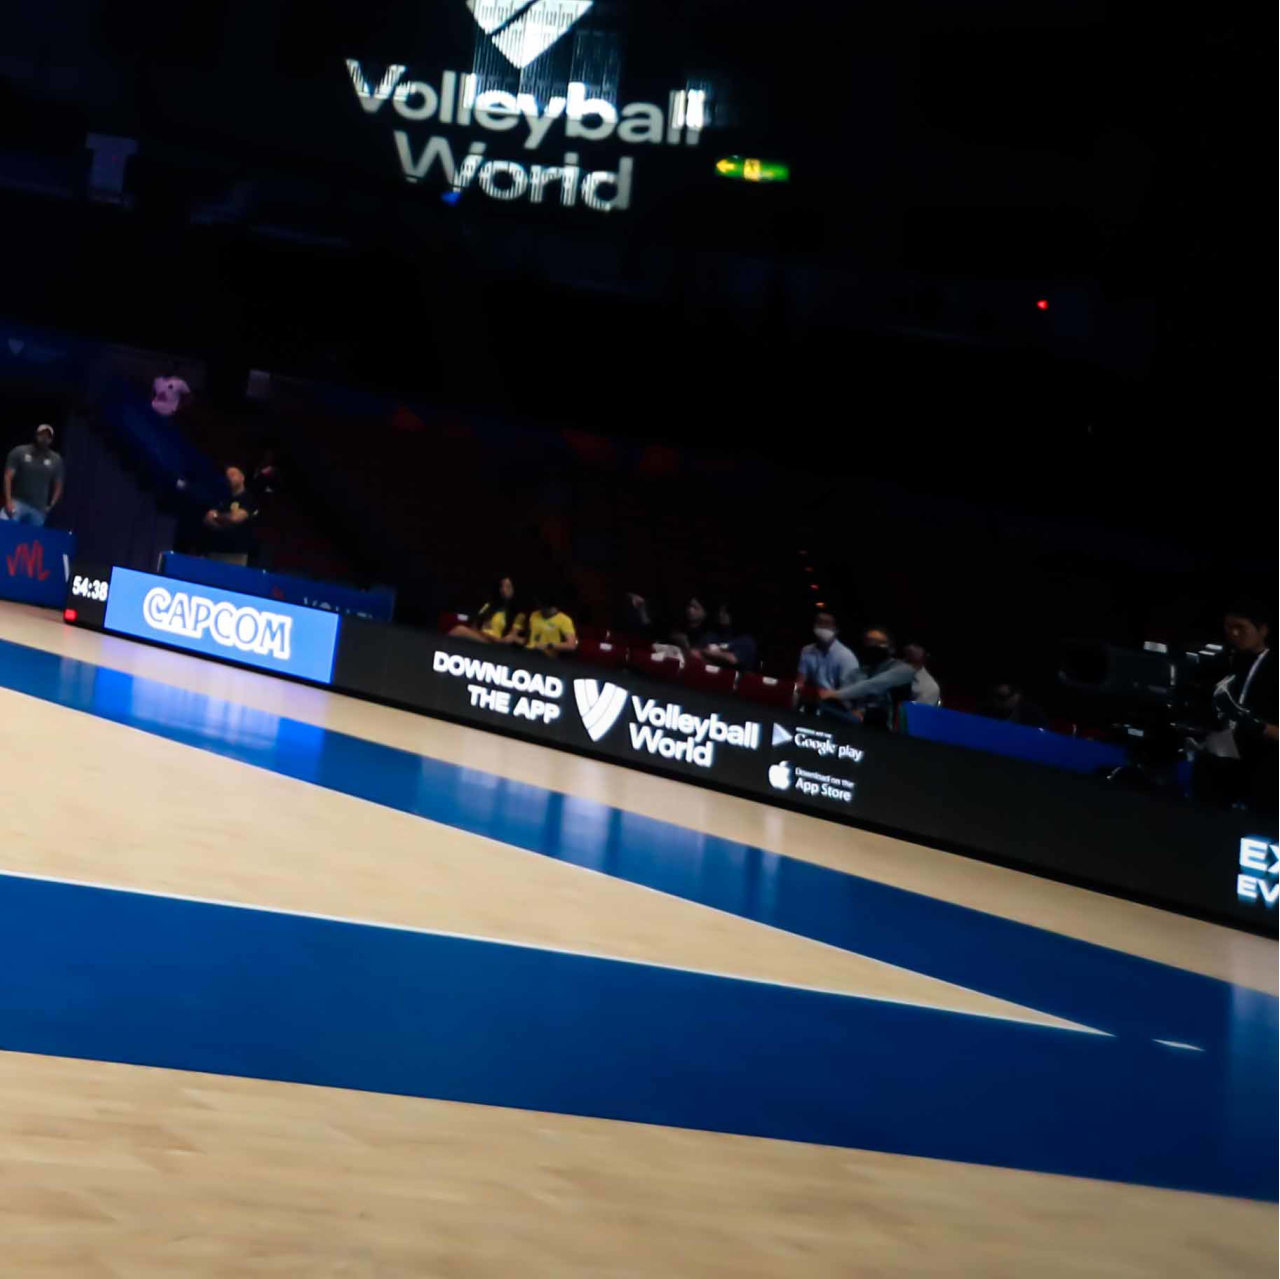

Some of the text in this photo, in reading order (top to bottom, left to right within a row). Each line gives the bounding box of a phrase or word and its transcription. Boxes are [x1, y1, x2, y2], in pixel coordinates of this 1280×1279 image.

[344, 58, 706, 150] Volleyball
[392, 129, 634, 211] World
[72, 575, 109, 602] 54:38
[143, 587, 293, 660] CAPCOM
[432, 650, 564, 699] DOWNLOAD
[467, 683, 561, 724] THE APP
[631, 694, 761, 751] Volleyball
[628, 721, 716, 768] World
[794, 733, 864, 763] Google play
[794, 777, 853, 803] App Store
